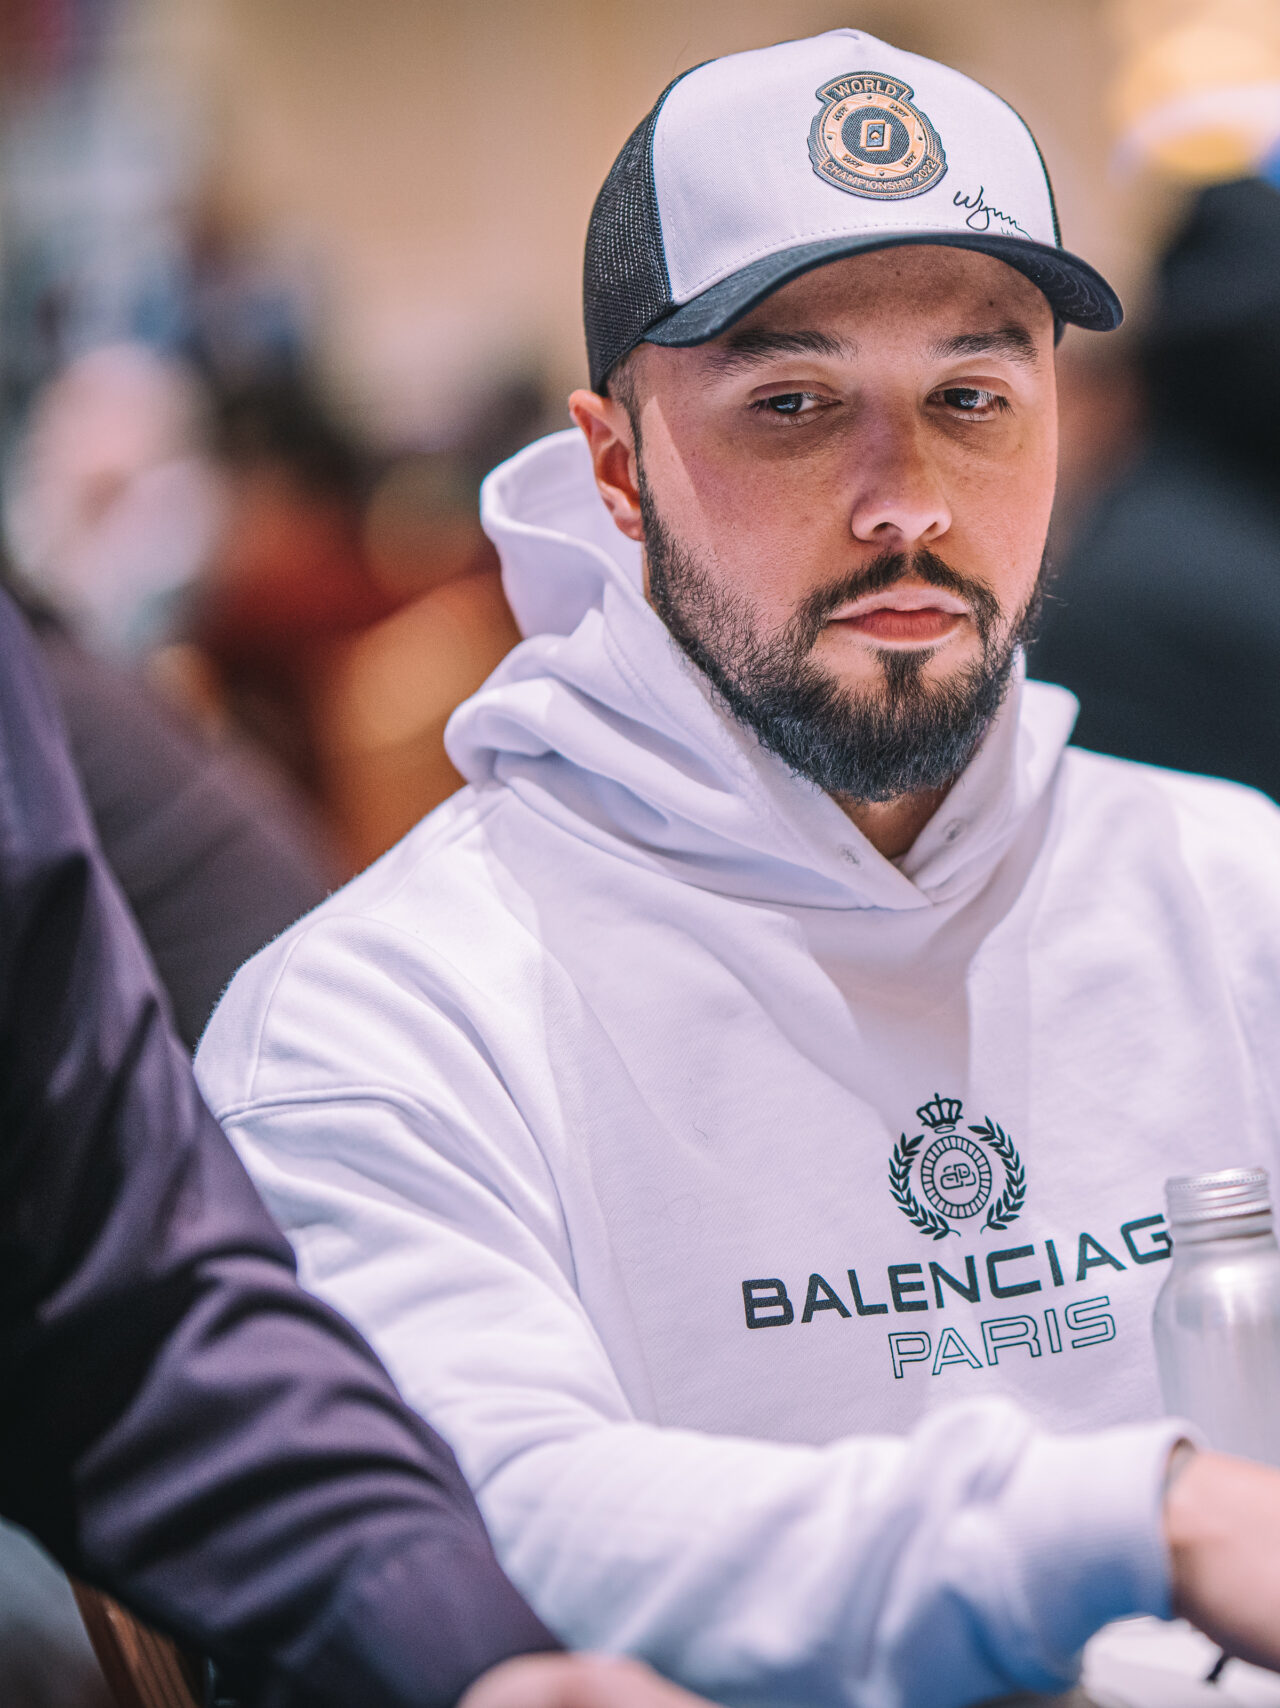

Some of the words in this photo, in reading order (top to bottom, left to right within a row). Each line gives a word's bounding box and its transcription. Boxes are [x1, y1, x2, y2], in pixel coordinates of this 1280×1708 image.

[834, 79, 898, 98] WORLD
[823, 160, 914, 191] CHAMPIONSHIP
[915, 159, 937, 184] 2022
[742, 1213, 1173, 1329] BALENCIAG
[888, 1295, 1117, 1379] PARIS
